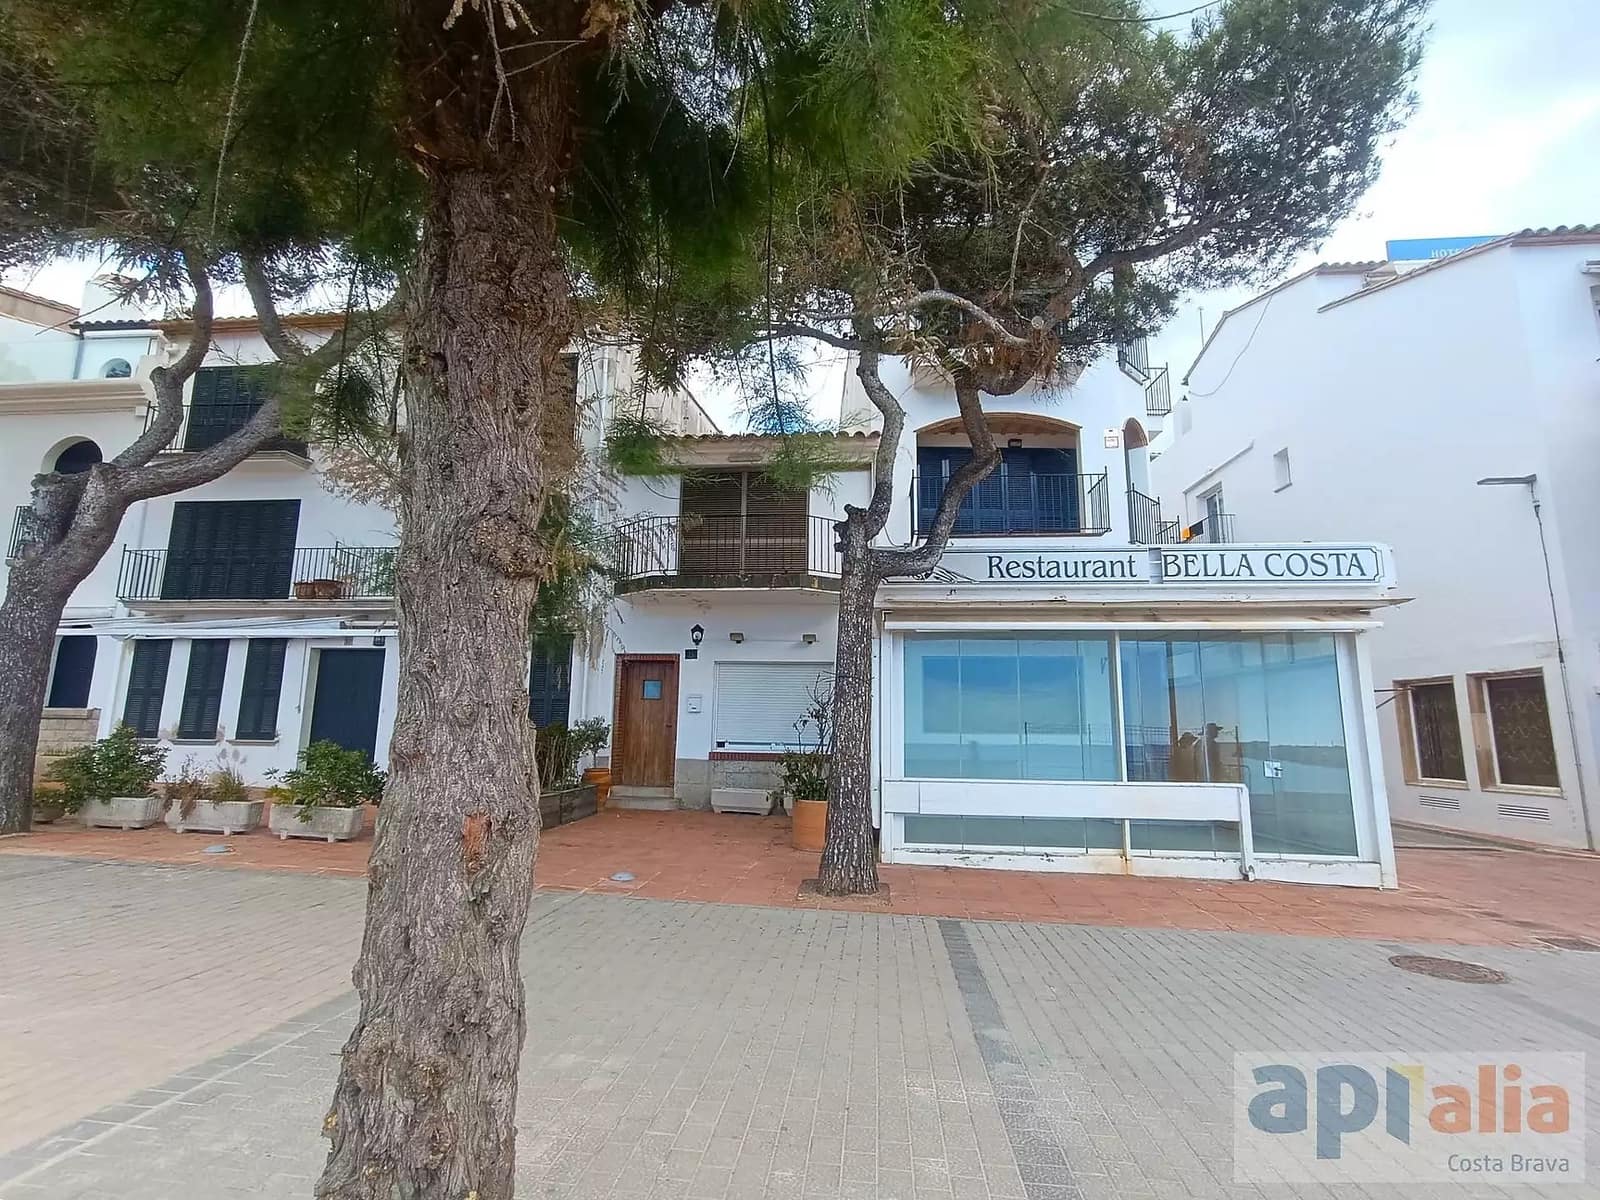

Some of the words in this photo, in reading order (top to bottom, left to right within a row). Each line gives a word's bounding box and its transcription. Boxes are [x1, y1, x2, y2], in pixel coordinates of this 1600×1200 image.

[1431, 248, 1461, 258] HOT
[987, 554, 1138, 579] Restaurant
[1163, 553, 1256, 577] BELLA
[1264, 553, 1368, 577] COSTA
